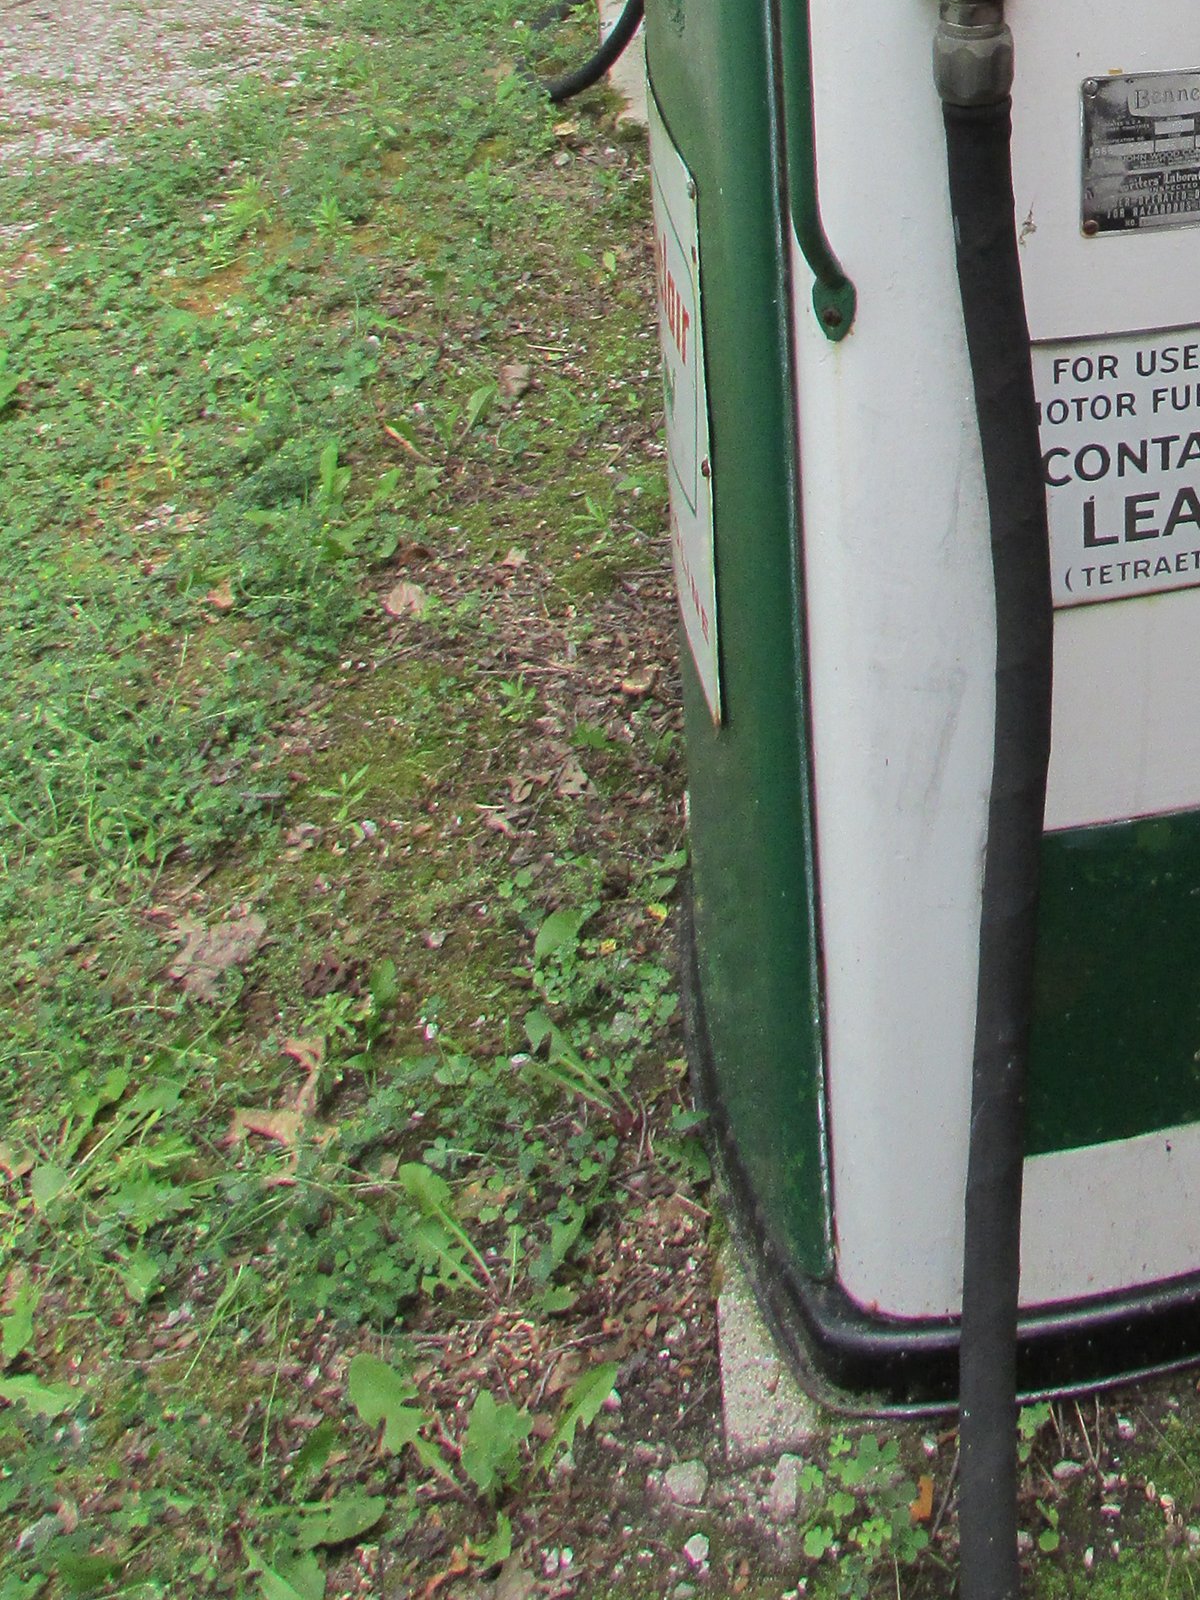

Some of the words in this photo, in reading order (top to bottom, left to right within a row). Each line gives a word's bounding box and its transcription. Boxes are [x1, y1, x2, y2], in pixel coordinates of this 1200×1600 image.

[1149, 148, 1181, 162] WOOD
[1053, 355, 1118, 384] FOR
[1136, 344, 1199, 377] USE
